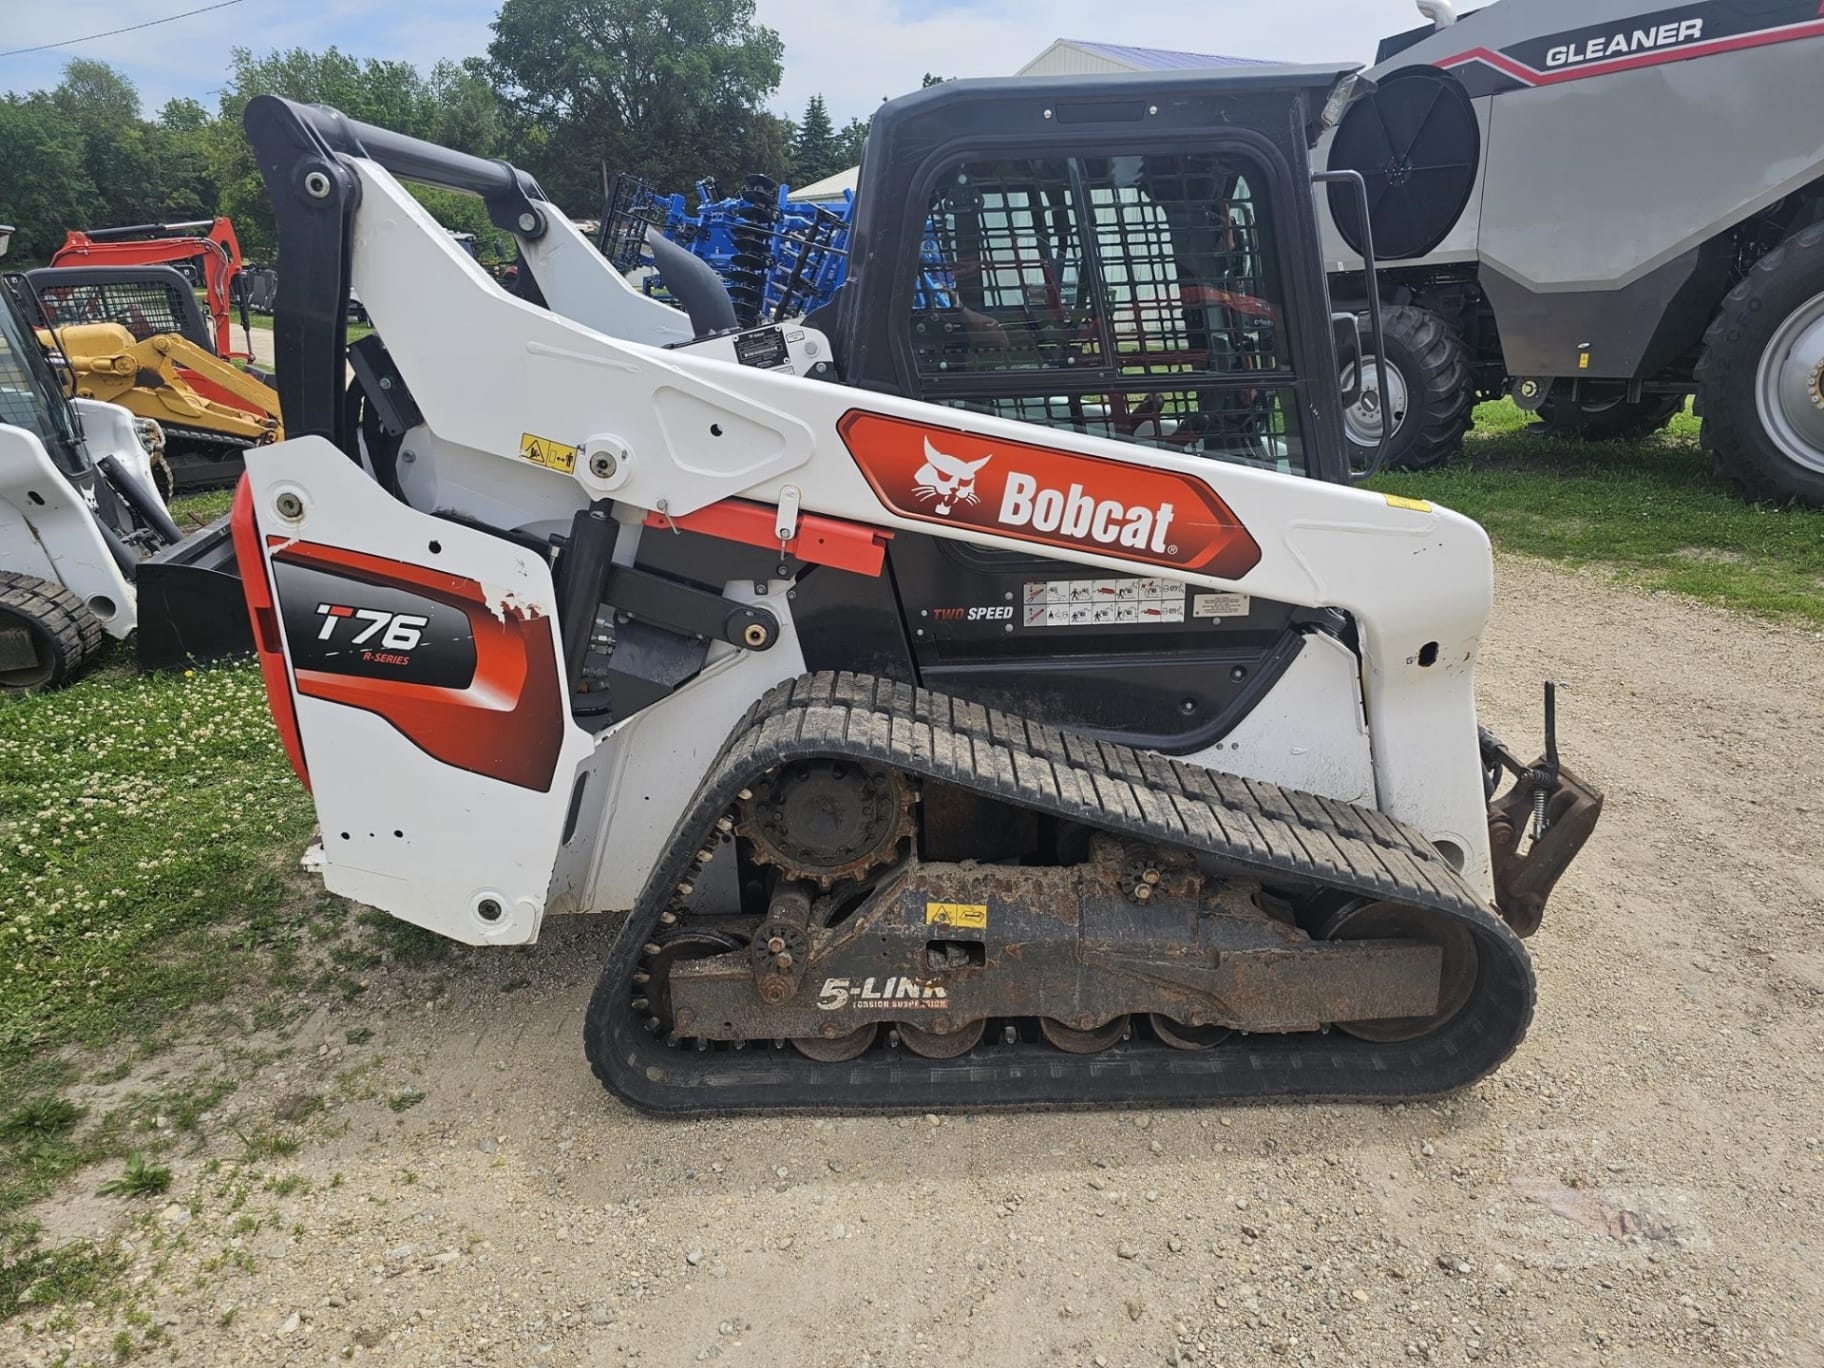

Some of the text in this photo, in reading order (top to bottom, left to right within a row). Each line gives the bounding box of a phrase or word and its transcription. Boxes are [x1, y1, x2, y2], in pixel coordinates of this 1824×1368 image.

[1546, 18, 1703, 66] GLEANER
[998, 471, 1175, 553] Bobcat
[316, 603, 428, 650] T76
[933, 606, 1014, 620] TWO SPEED
[363, 652, 410, 665] R-SERIES
